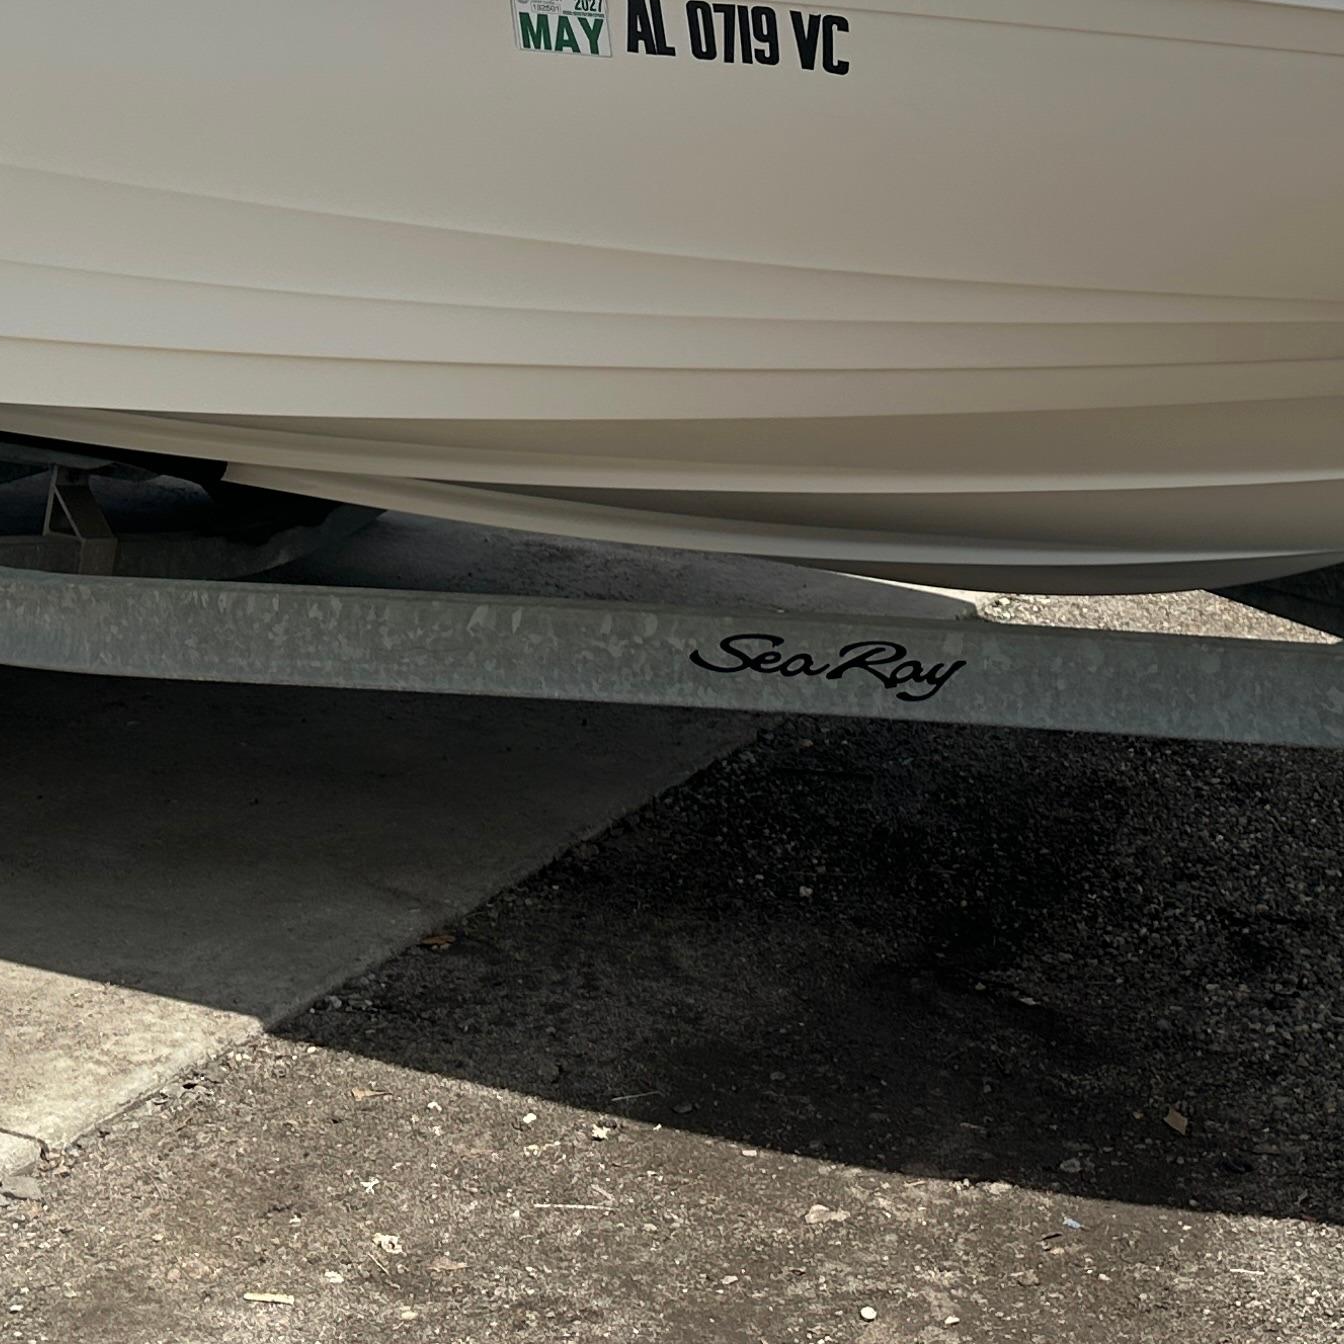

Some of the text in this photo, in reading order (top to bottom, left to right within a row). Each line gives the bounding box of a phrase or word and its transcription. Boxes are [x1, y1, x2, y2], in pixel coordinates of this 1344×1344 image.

[518, 11, 604, 55] MAY
[685, 0, 780, 66] 0719
[789, 9, 850, 76] VC
[689, 633, 967, 702] Sea Ray
